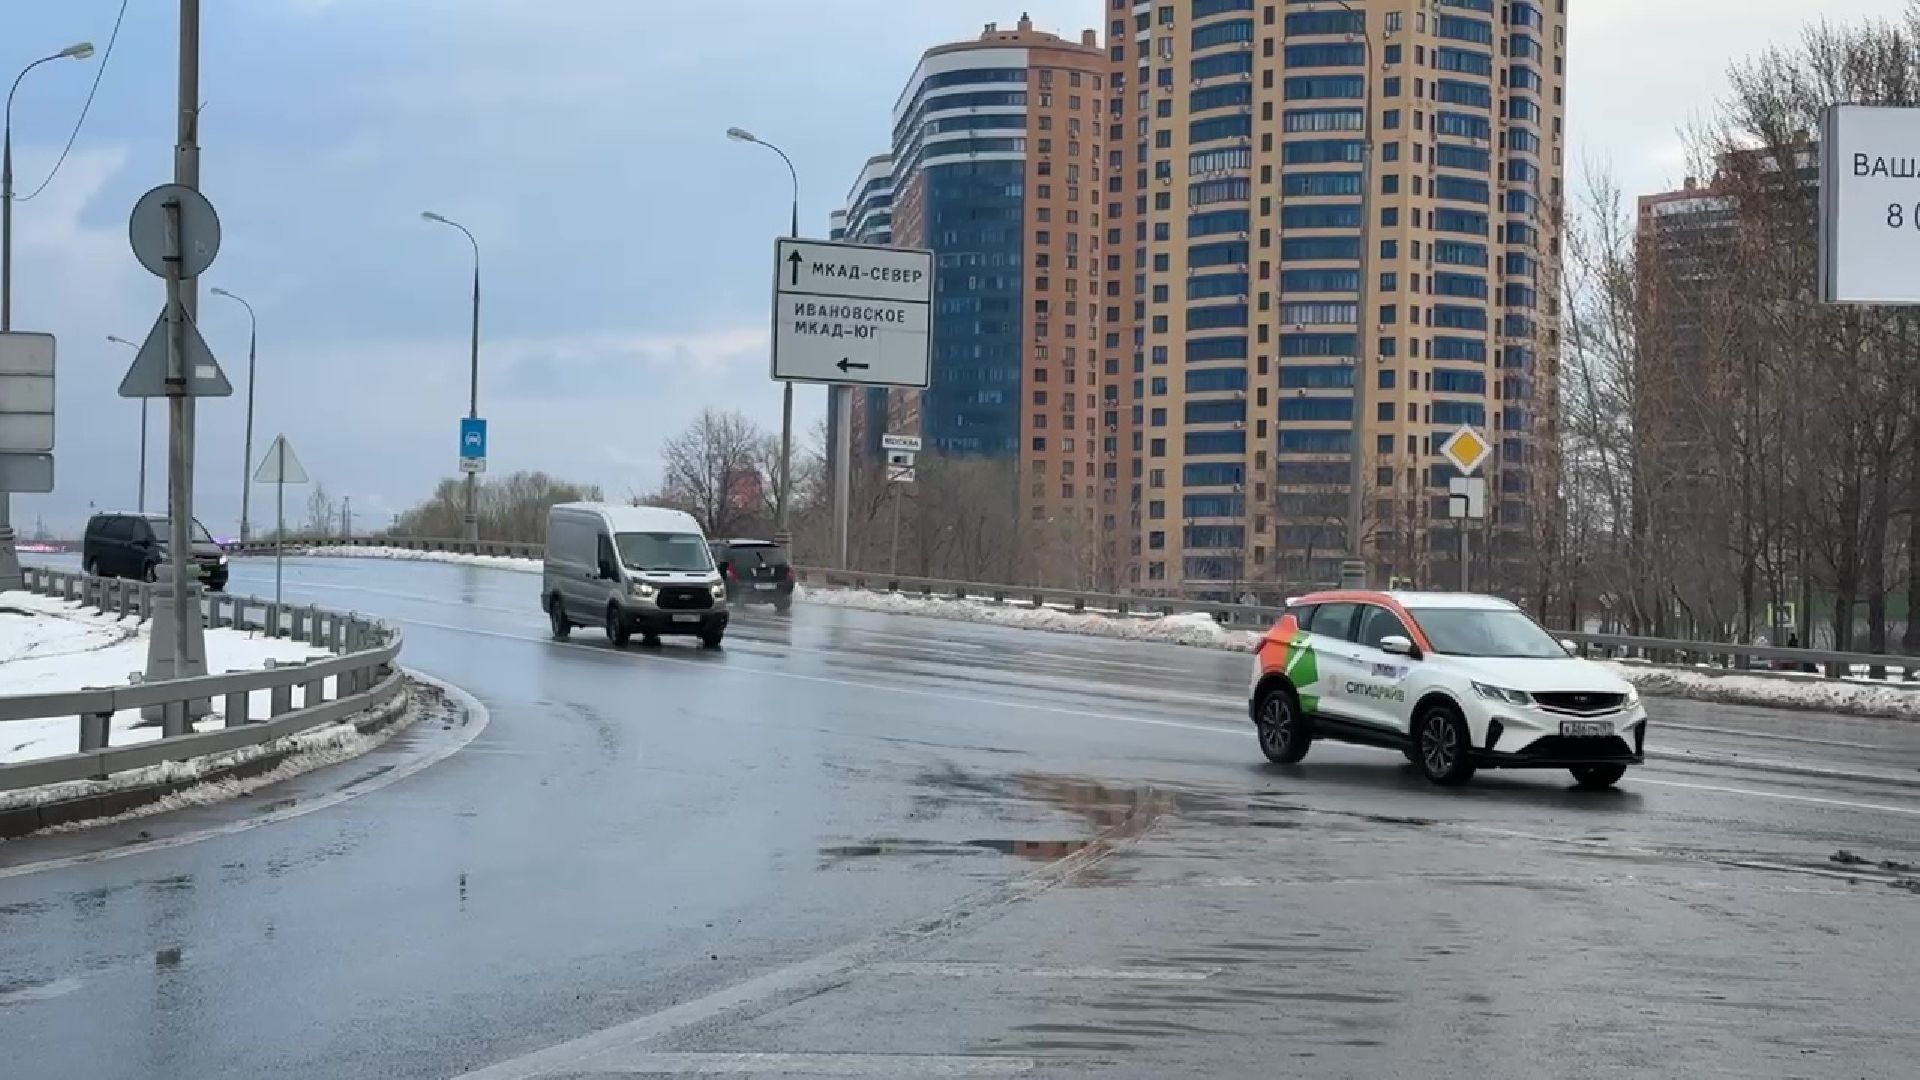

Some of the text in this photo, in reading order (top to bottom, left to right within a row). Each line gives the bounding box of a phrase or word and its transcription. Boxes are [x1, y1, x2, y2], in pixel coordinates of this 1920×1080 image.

[1854, 153, 1920, 177] ВАШ
[1887, 203, 1903, 228] 8
[812, 261, 922, 283] МКАД-СЕВЕР
[794, 303, 905, 323] ИВАНОВСКОЕ
[794, 321, 878, 339] МКАД-ЮГ
